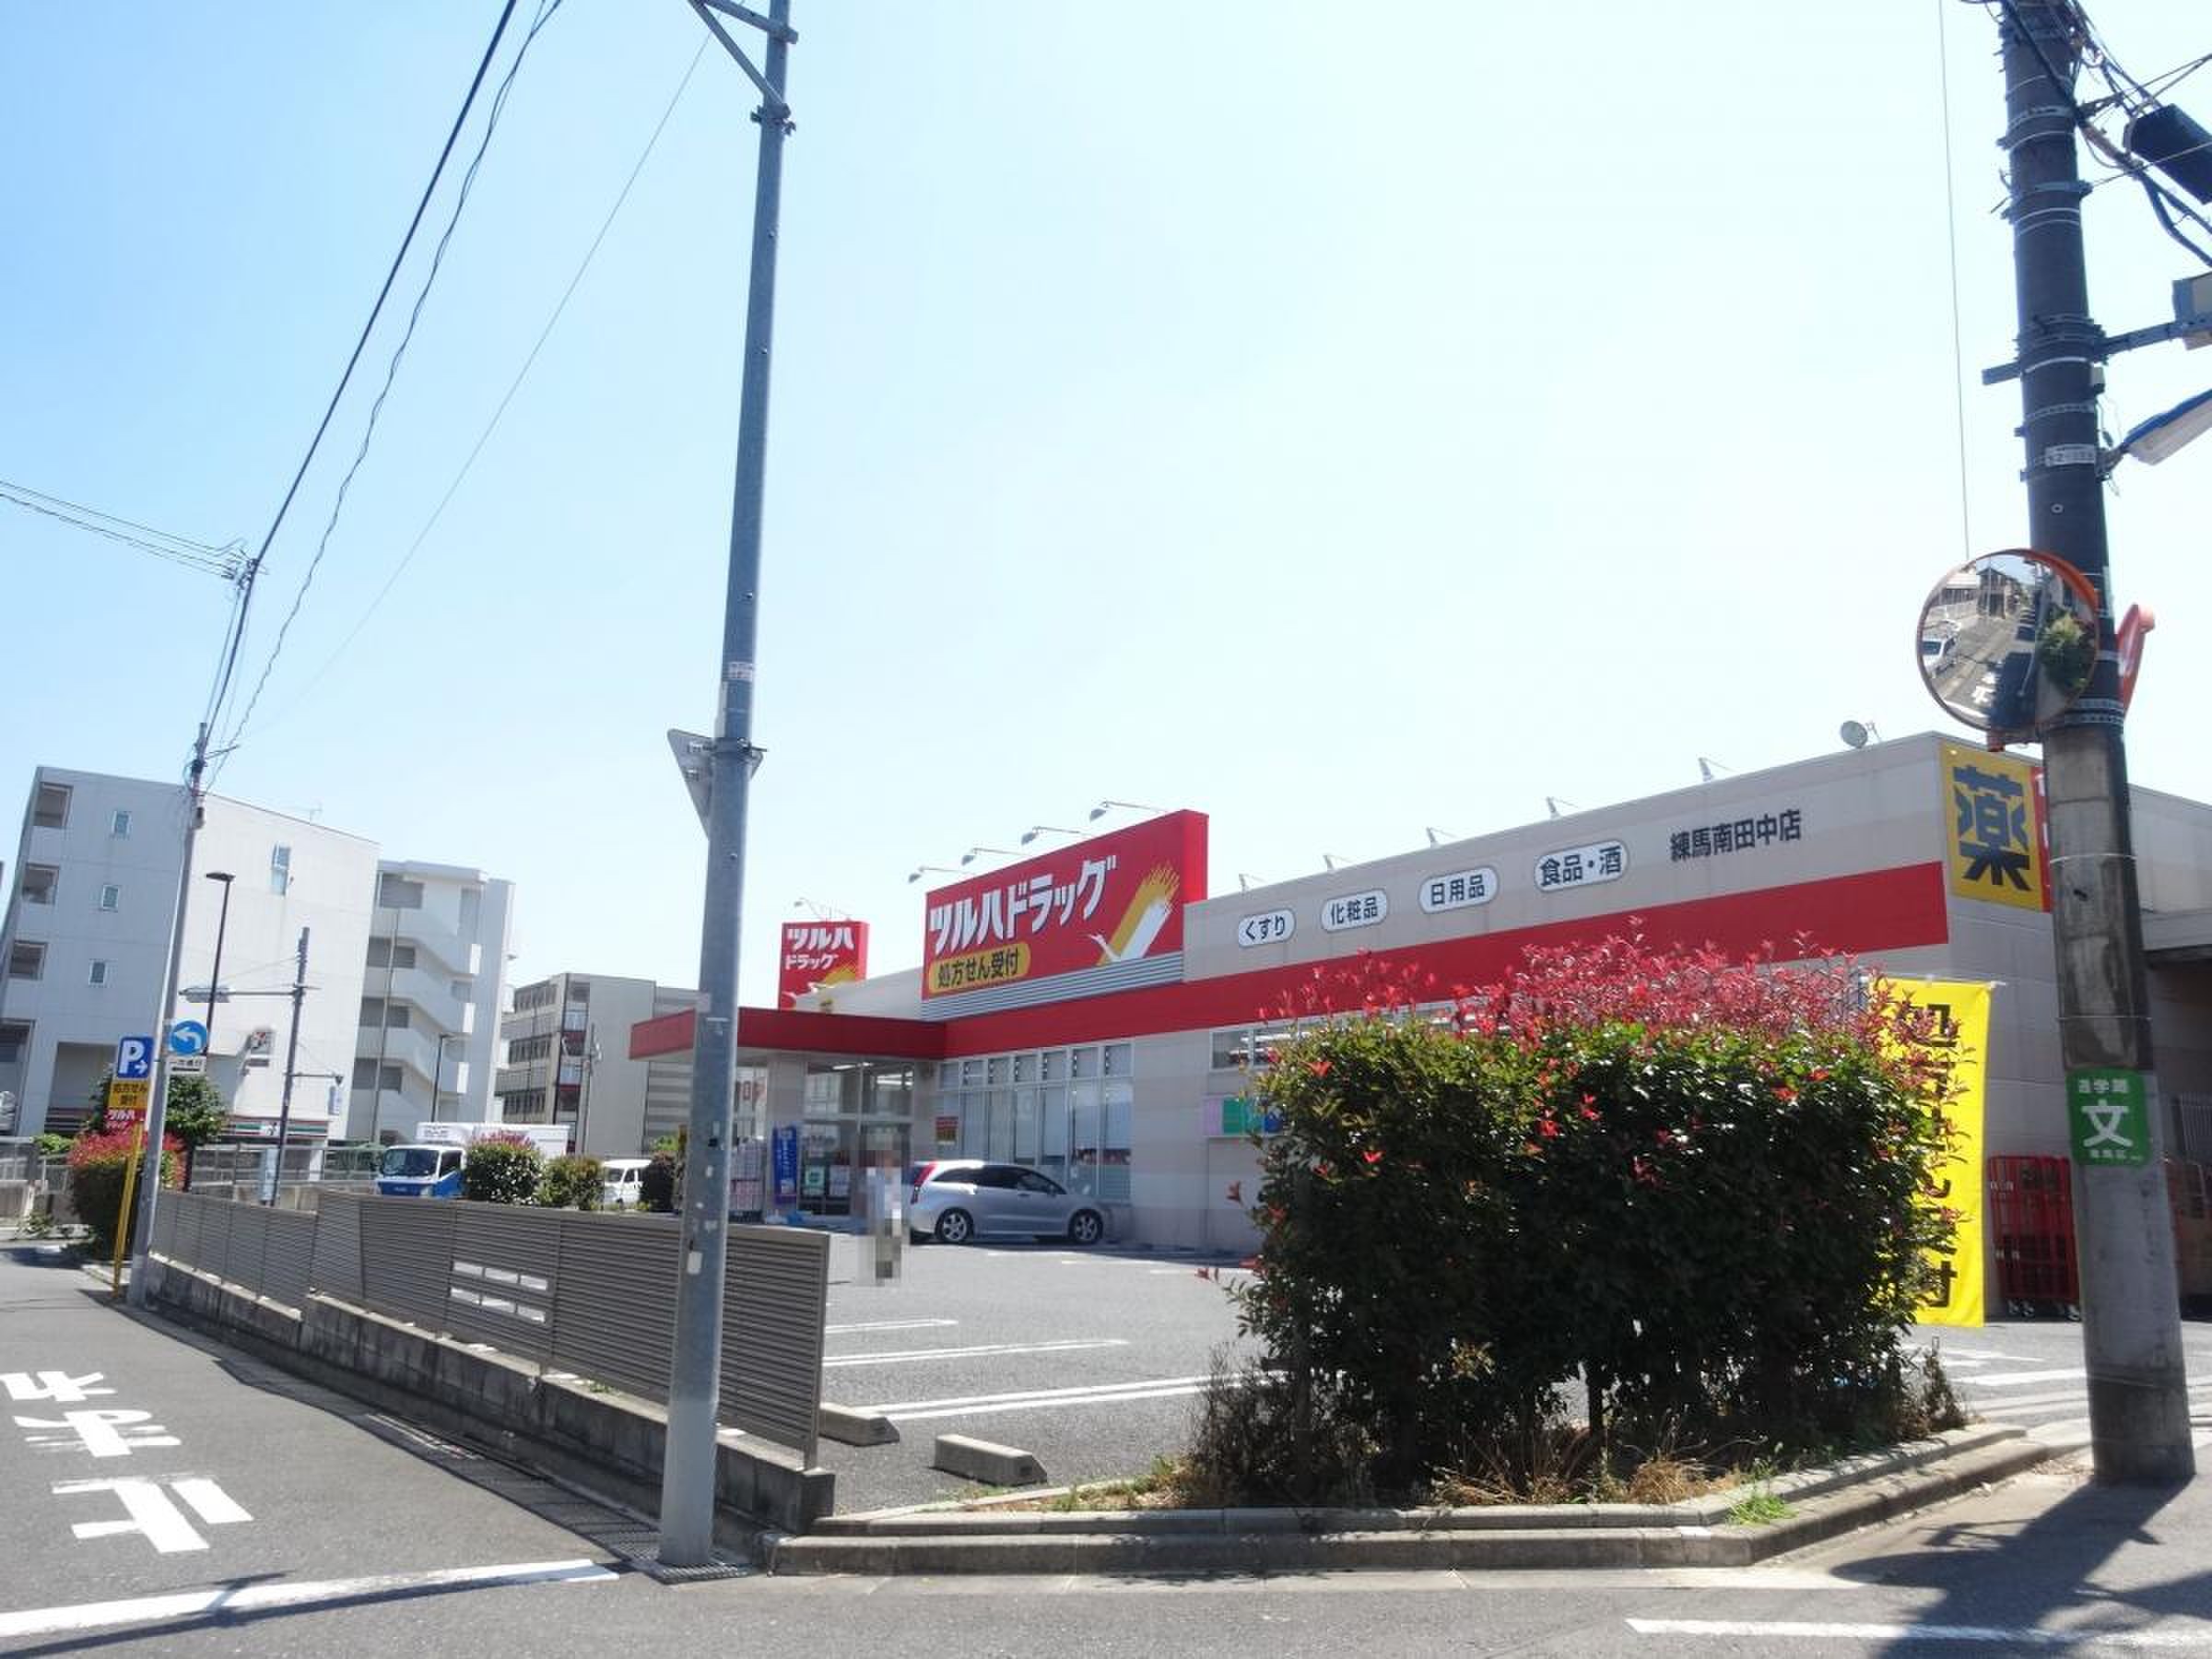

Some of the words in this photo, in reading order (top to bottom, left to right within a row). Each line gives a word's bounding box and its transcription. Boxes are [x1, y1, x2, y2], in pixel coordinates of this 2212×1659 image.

[1669, 810, 1802, 863] 練馬南田中店
[1953, 765, 2031, 891] 薬
[1540, 846, 1622, 888] 食品・酒
[928, 854, 1117, 954] ツルハドラッグ
[1329, 891, 1379, 925] 化粧品
[1430, 874, 1486, 906] 日用品
[787, 928, 855, 950] ツルハ
[1243, 914, 1287, 941] くすり
[785, 953, 839, 971] ドラッグ
[936, 949, 1019, 989] 処方せん受付
[119, 1040, 145, 1075] P
[2081, 1099, 2134, 1147] 文
